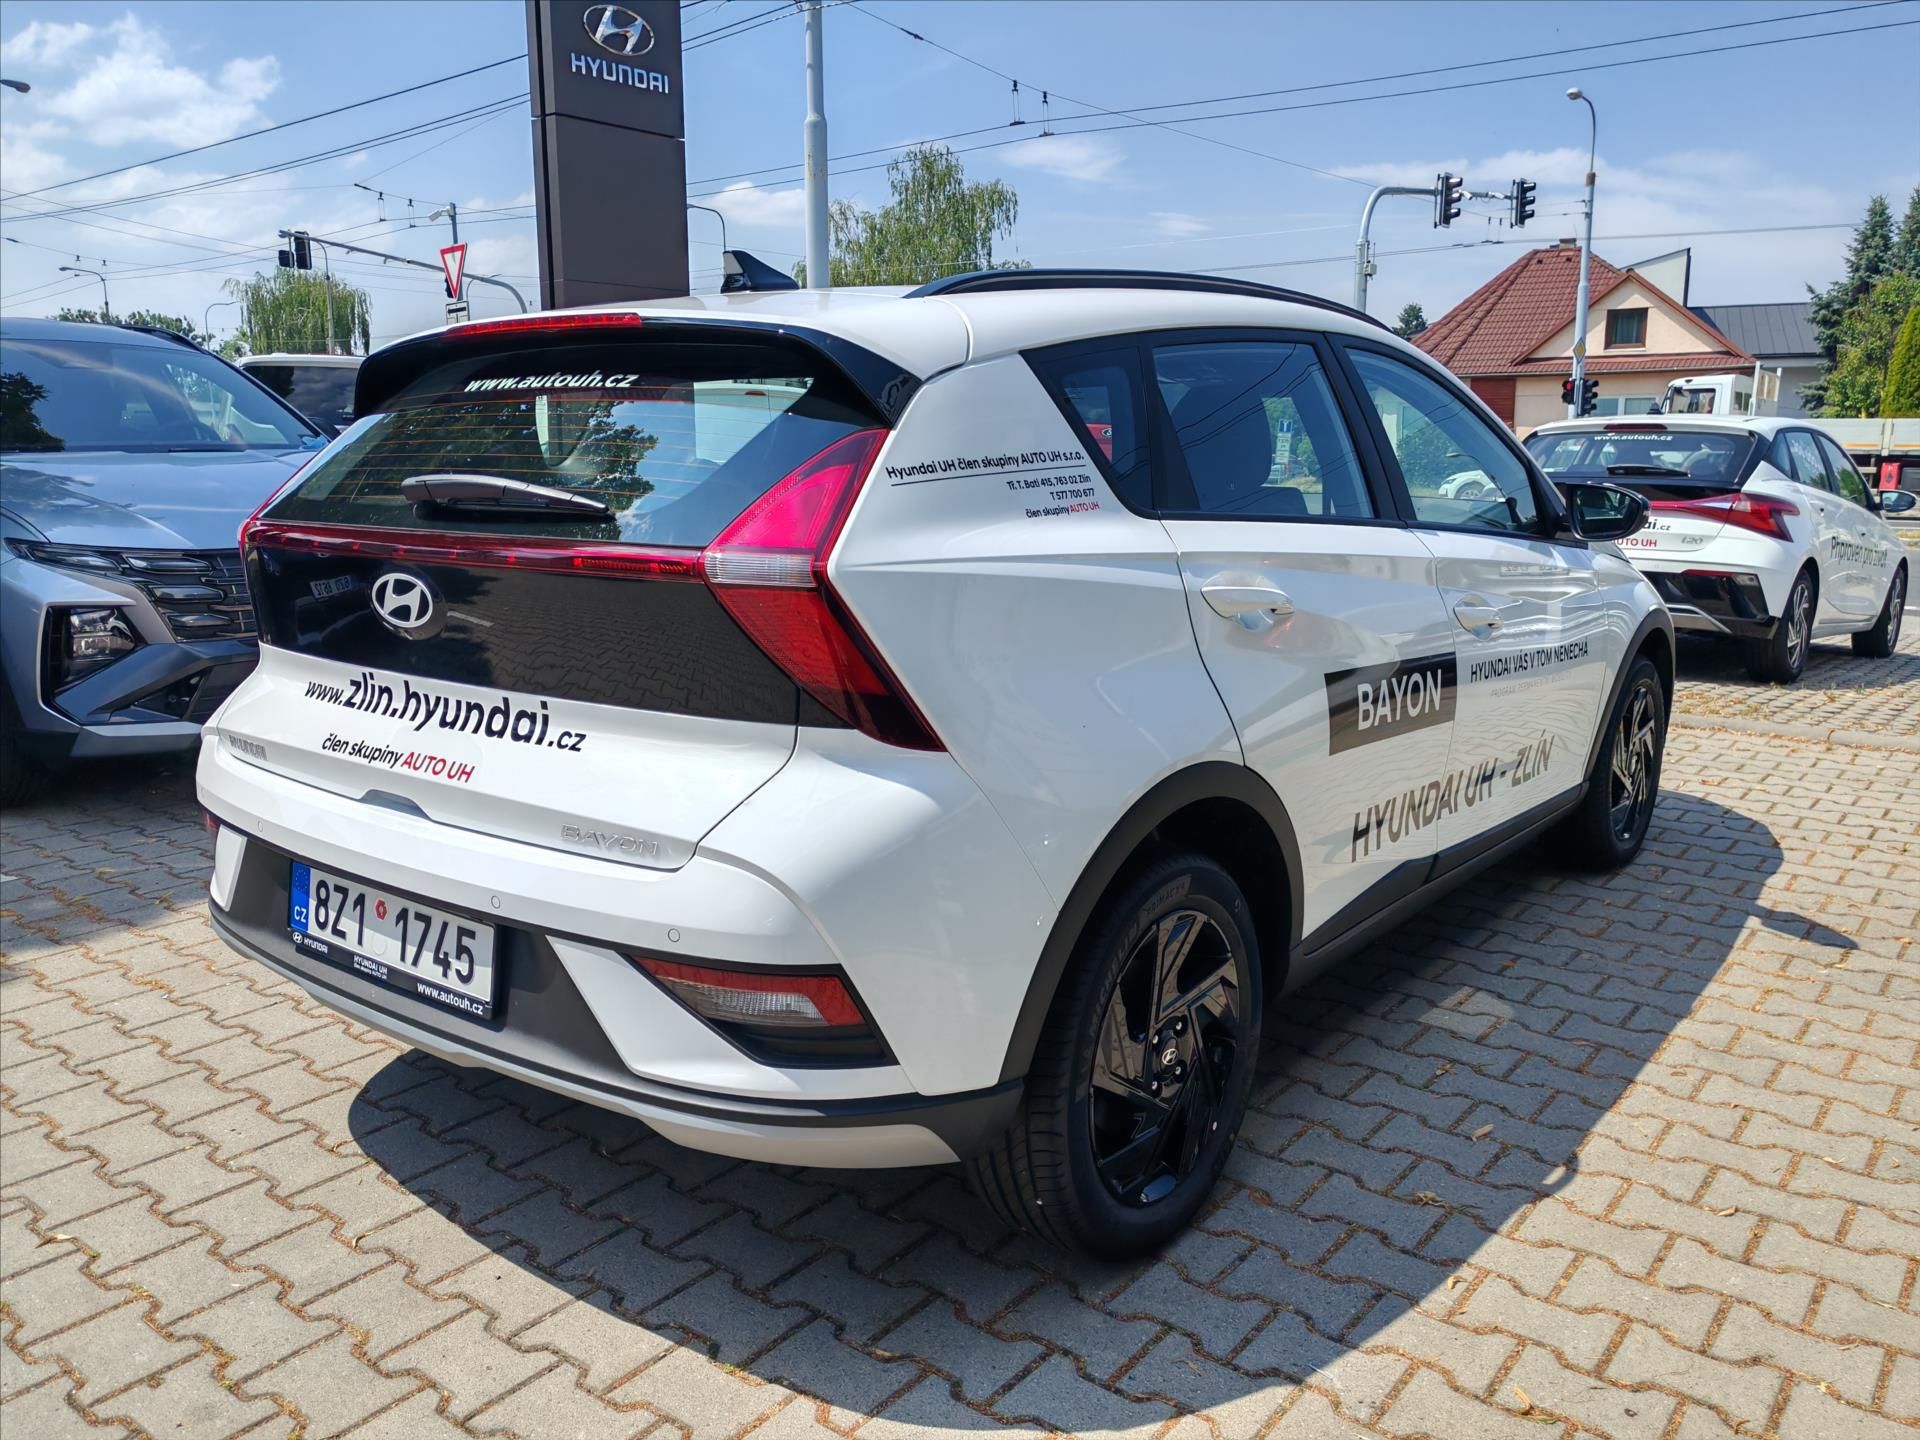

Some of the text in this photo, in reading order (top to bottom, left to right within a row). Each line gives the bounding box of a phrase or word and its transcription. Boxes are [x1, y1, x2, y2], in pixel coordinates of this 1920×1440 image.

[571, 52, 669, 94] HYUNDAI
[464, 369, 640, 393] www.autouh.cz
[1594, 433, 1673, 441] www.autouh.cz
[885, 450, 1085, 480] Hyundai UH člen skupiny AUTO UH s.r.o.
[1017, 480, 1025, 490] T.
[1024, 478, 1041, 489] Bati
[1040, 477, 1056, 487] 415,
[1054, 476, 1068, 486] 763
[1068, 475, 1078, 485] 02
[1050, 488, 1095, 501] T 577 700 677
[1025, 500, 1101, 519] člen skupiny AUTO UH
[1641, 538, 1658, 547] UH
[1470, 655, 1512, 683] HYUNDAI
[1512, 649, 1528, 672] VÁS
[1528, 651, 1536, 668] V
[1536, 647, 1552, 668] TOM
[304, 671, 588, 753] www.zlin.hyundai.cz
[1357, 669, 1442, 731] BAYON
[321, 732, 476, 784] člen skupiny AUTO UH
[1351, 769, 1464, 864] HYUNDAI
[1463, 757, 1498, 808] UH
[1511, 728, 1555, 788] ZLÍN
[560, 823, 659, 857] BAYON
[293, 905, 308, 924] CZ
[314, 879, 477, 985] 8Z1 1745
[417, 982, 484, 1015] www.autouh.cz
